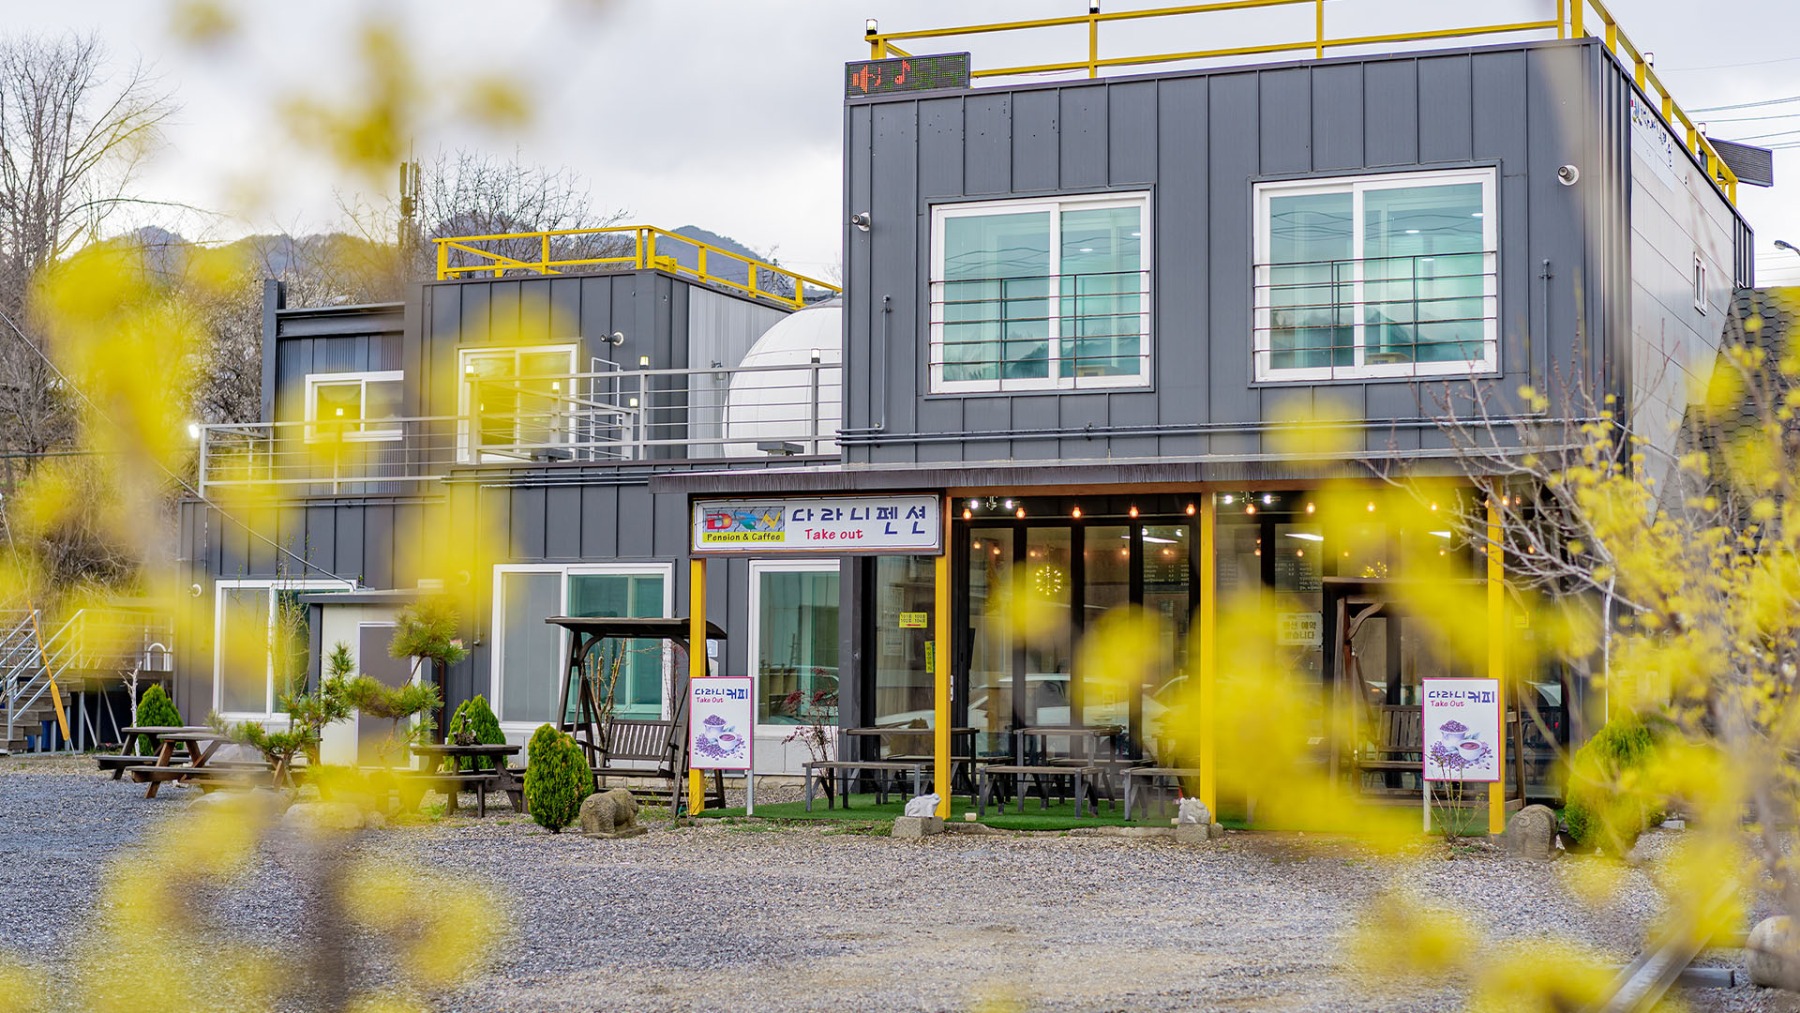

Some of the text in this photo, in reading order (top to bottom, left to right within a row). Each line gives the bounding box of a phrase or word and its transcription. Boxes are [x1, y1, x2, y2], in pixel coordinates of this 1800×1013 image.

[791, 505, 926, 534] 다라니펜션
[707, 533, 781, 541] Pension & Caffee
[804, 528, 863, 540] Take out
[1284, 631, 1315, 640] 습니다
